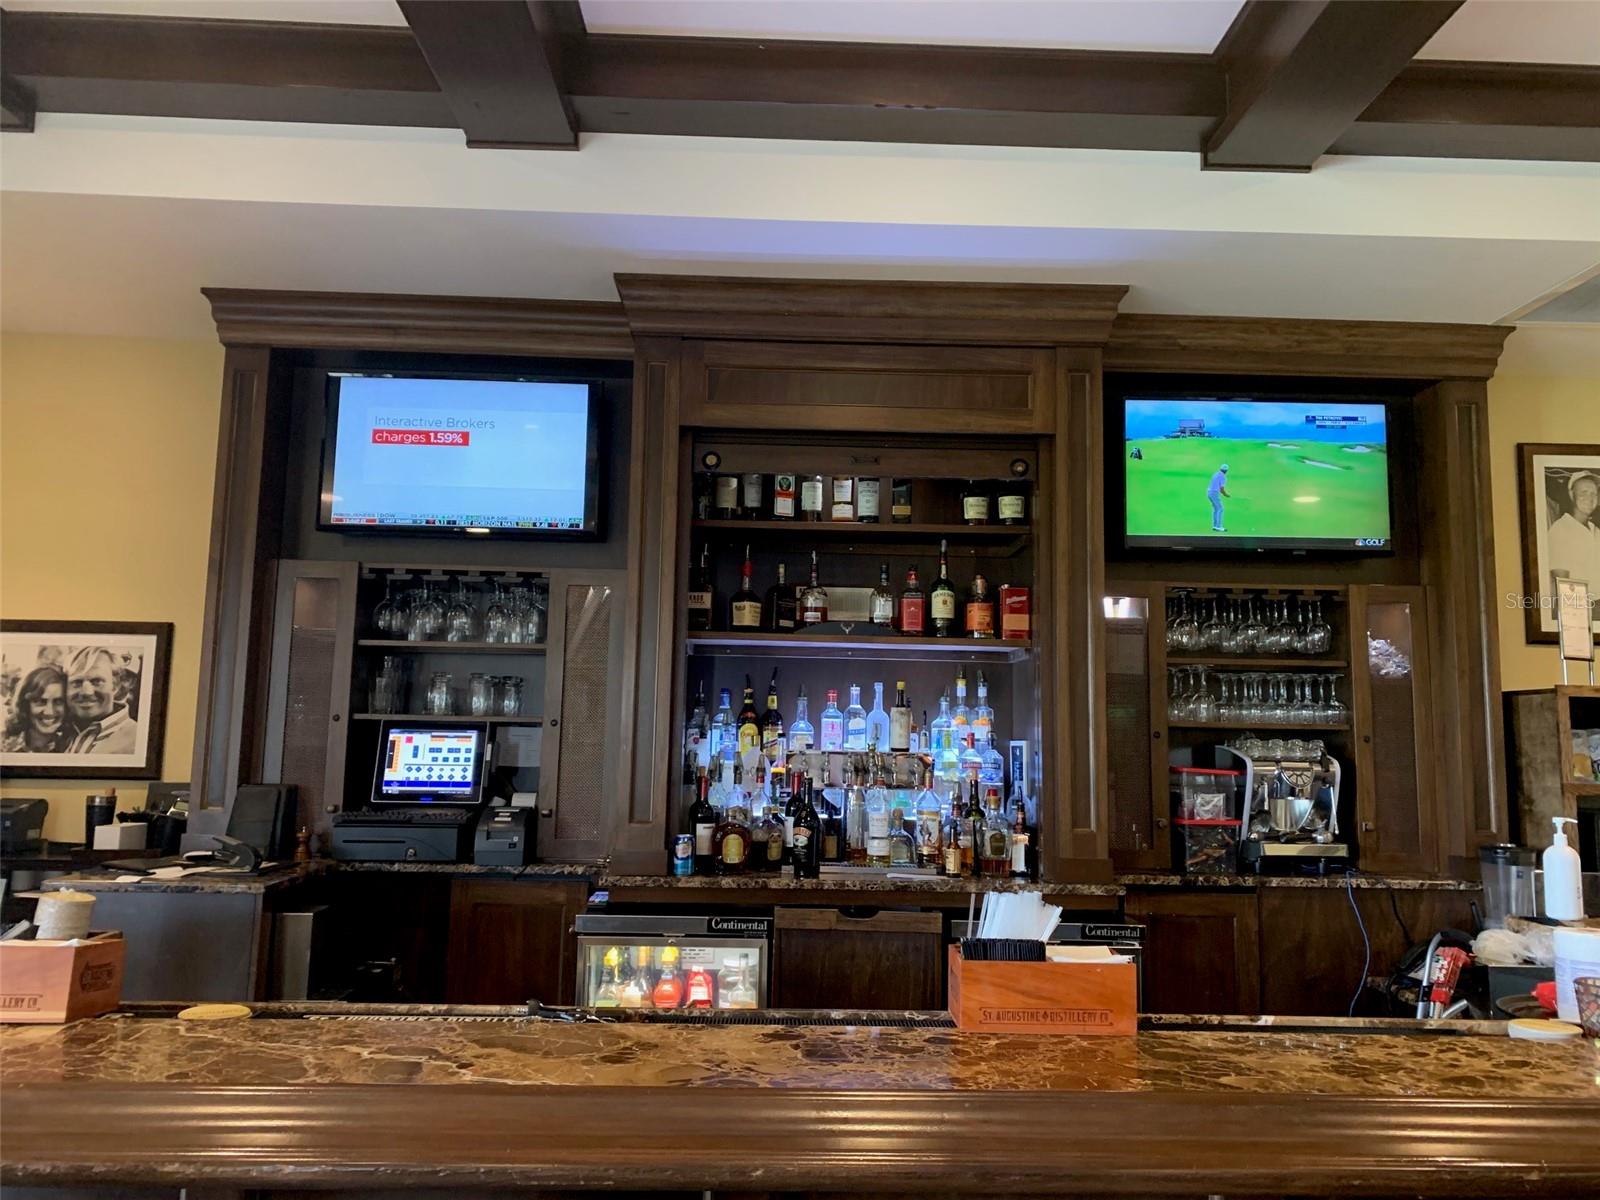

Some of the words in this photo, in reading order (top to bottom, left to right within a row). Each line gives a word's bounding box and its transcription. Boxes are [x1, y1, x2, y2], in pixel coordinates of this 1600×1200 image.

[374, 415, 442, 428] Interactive
[446, 417, 496, 430] Brokers
[375, 430, 426, 444] charges
[428, 431, 463, 444] 1.59%
[711, 916, 768, 931] Continental
[1085, 923, 1140, 938] Continental
[0, 997, 25, 1009] LERY
[996, 1010, 1041, 1022] AUGUSTINE
[1049, 1011, 1096, 1023] DISTILLERY
